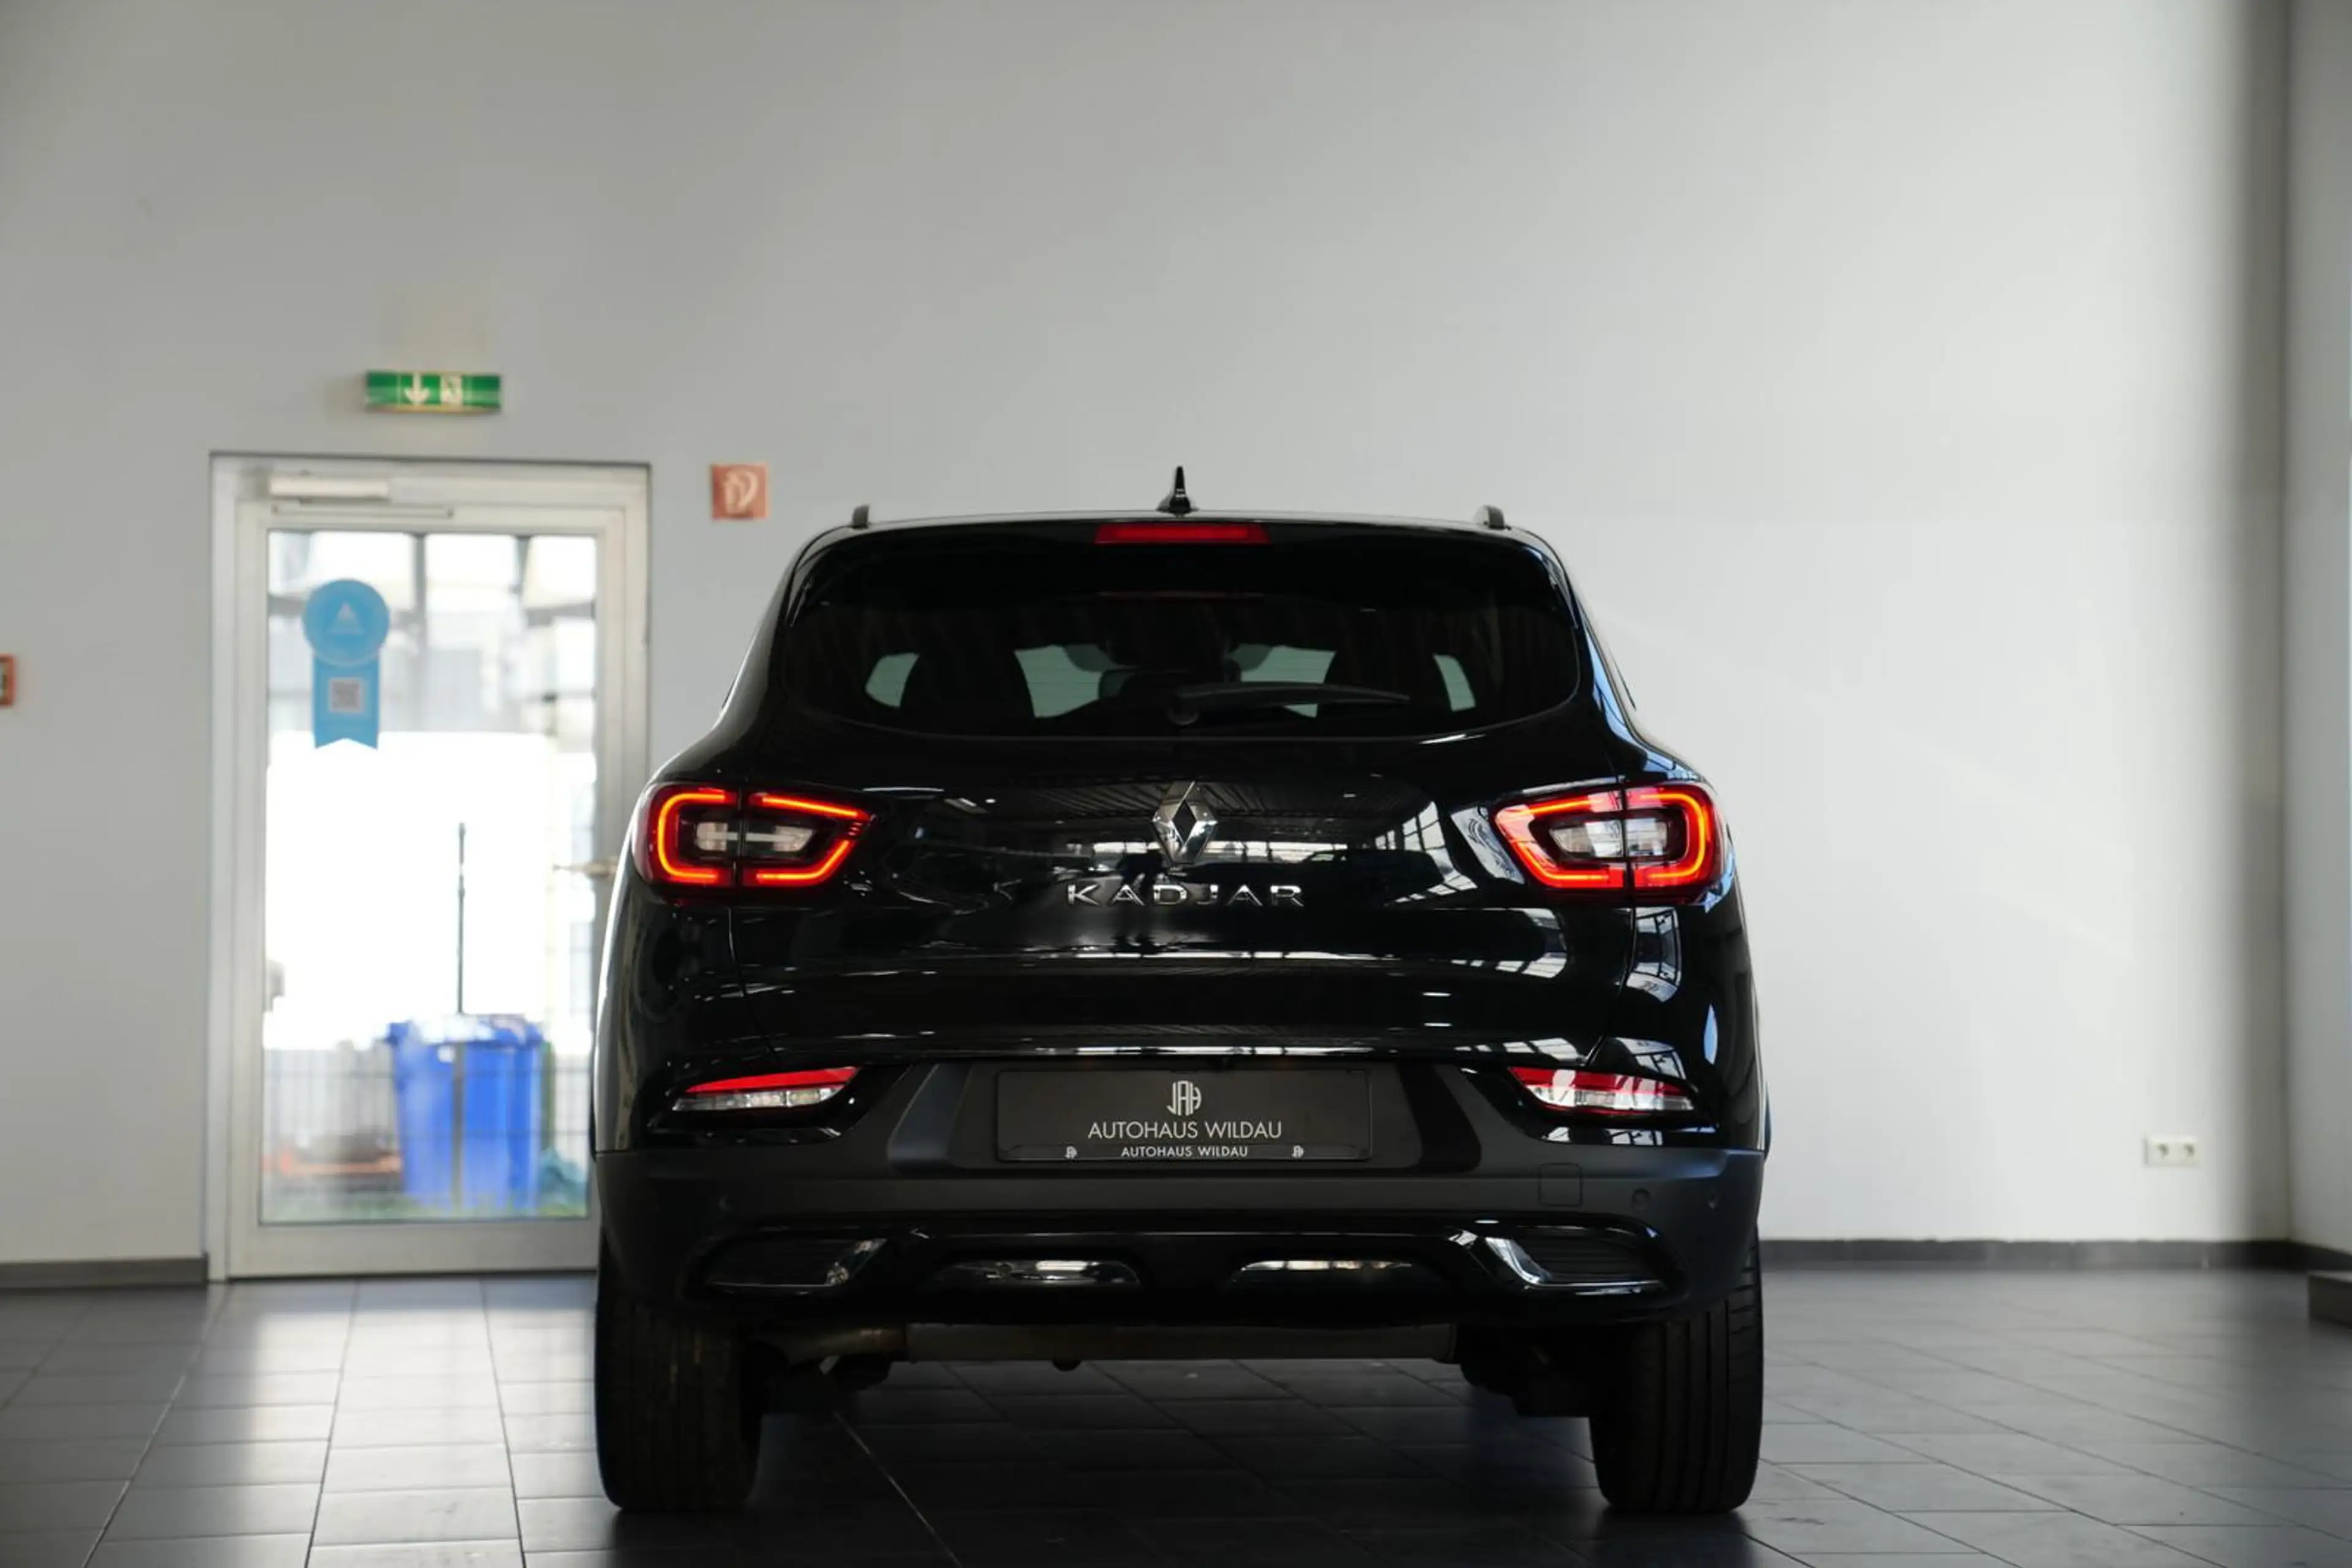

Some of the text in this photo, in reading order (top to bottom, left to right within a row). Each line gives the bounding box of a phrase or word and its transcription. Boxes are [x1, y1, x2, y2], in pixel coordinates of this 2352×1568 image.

[1066, 884, 1305, 907] KADJAR
[1088, 1121, 1282, 1139] AUTOHAUS WILDAU
[1121, 1146, 1248, 1157] AUTOHAUS WILDAU
